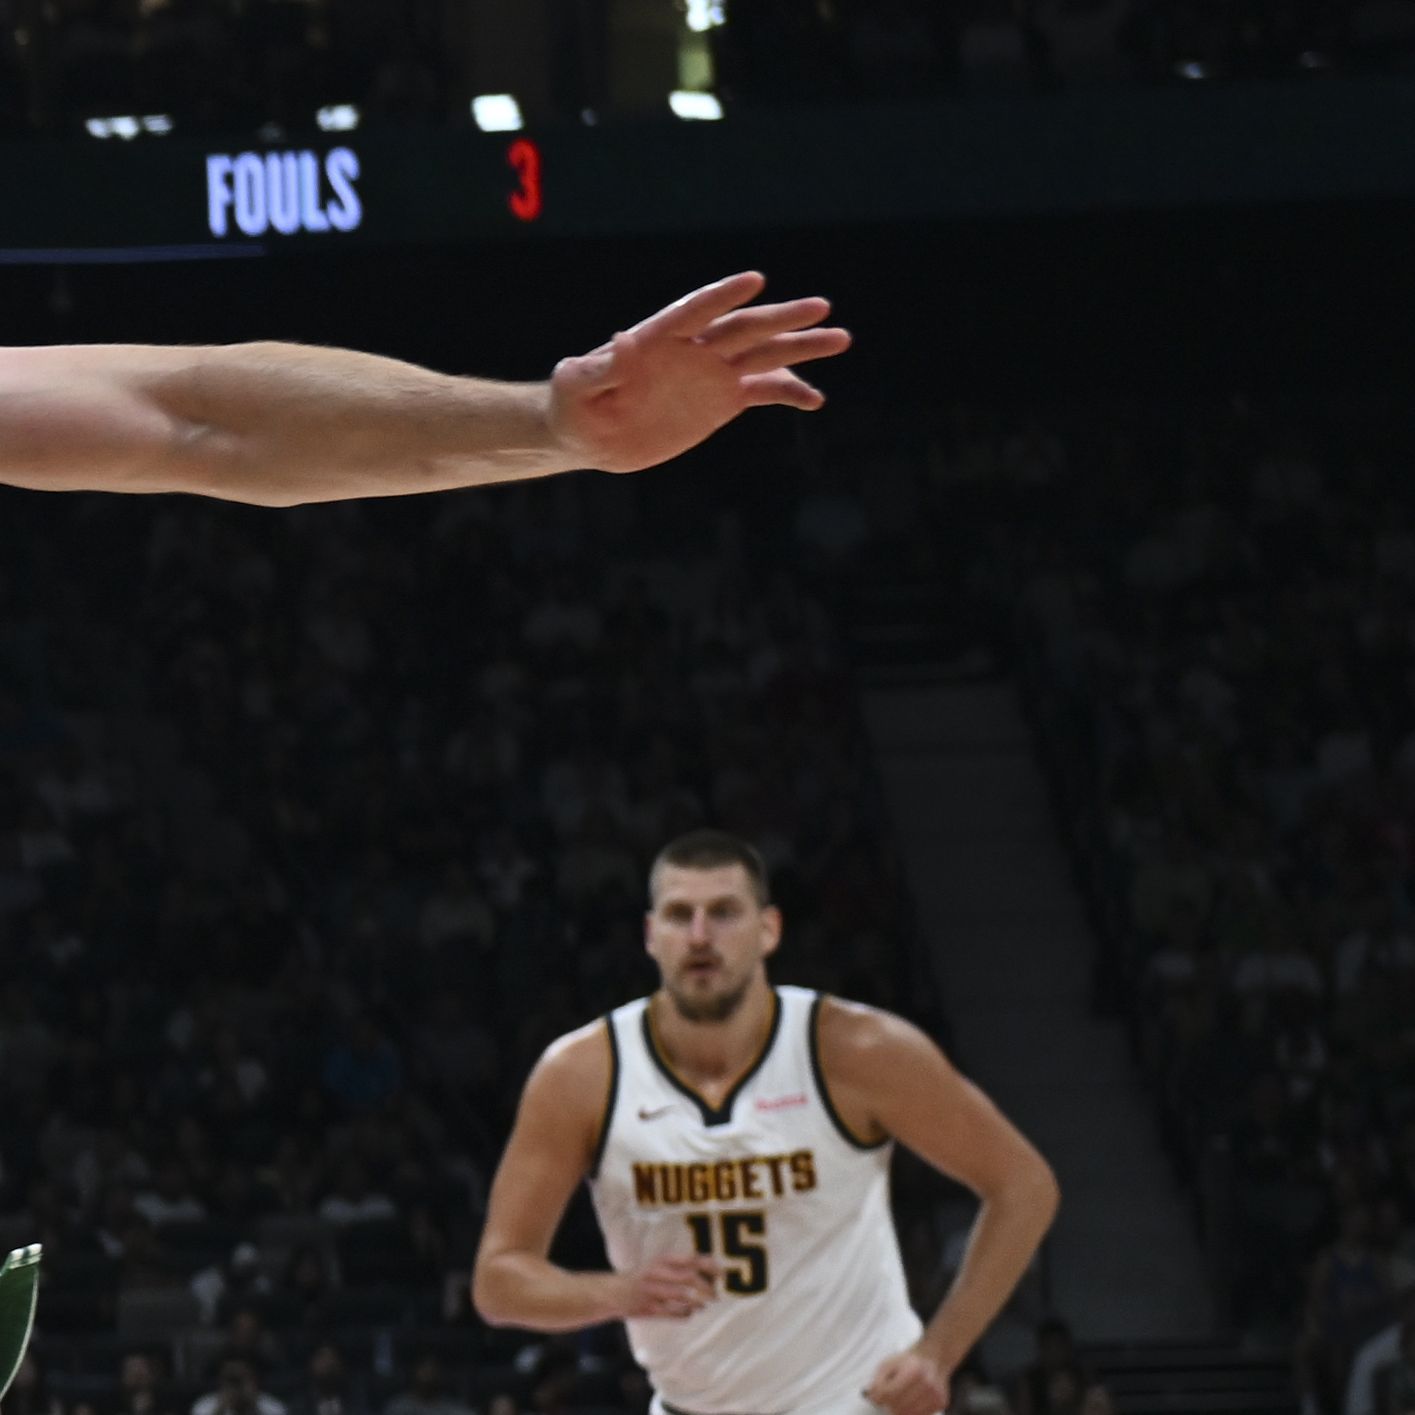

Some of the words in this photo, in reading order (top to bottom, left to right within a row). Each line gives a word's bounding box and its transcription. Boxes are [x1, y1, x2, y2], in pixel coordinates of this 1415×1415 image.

[205, 147, 362, 237] FOULS
[508, 138, 542, 221] 3
[631, 1149, 818, 1208] NUGGETS
